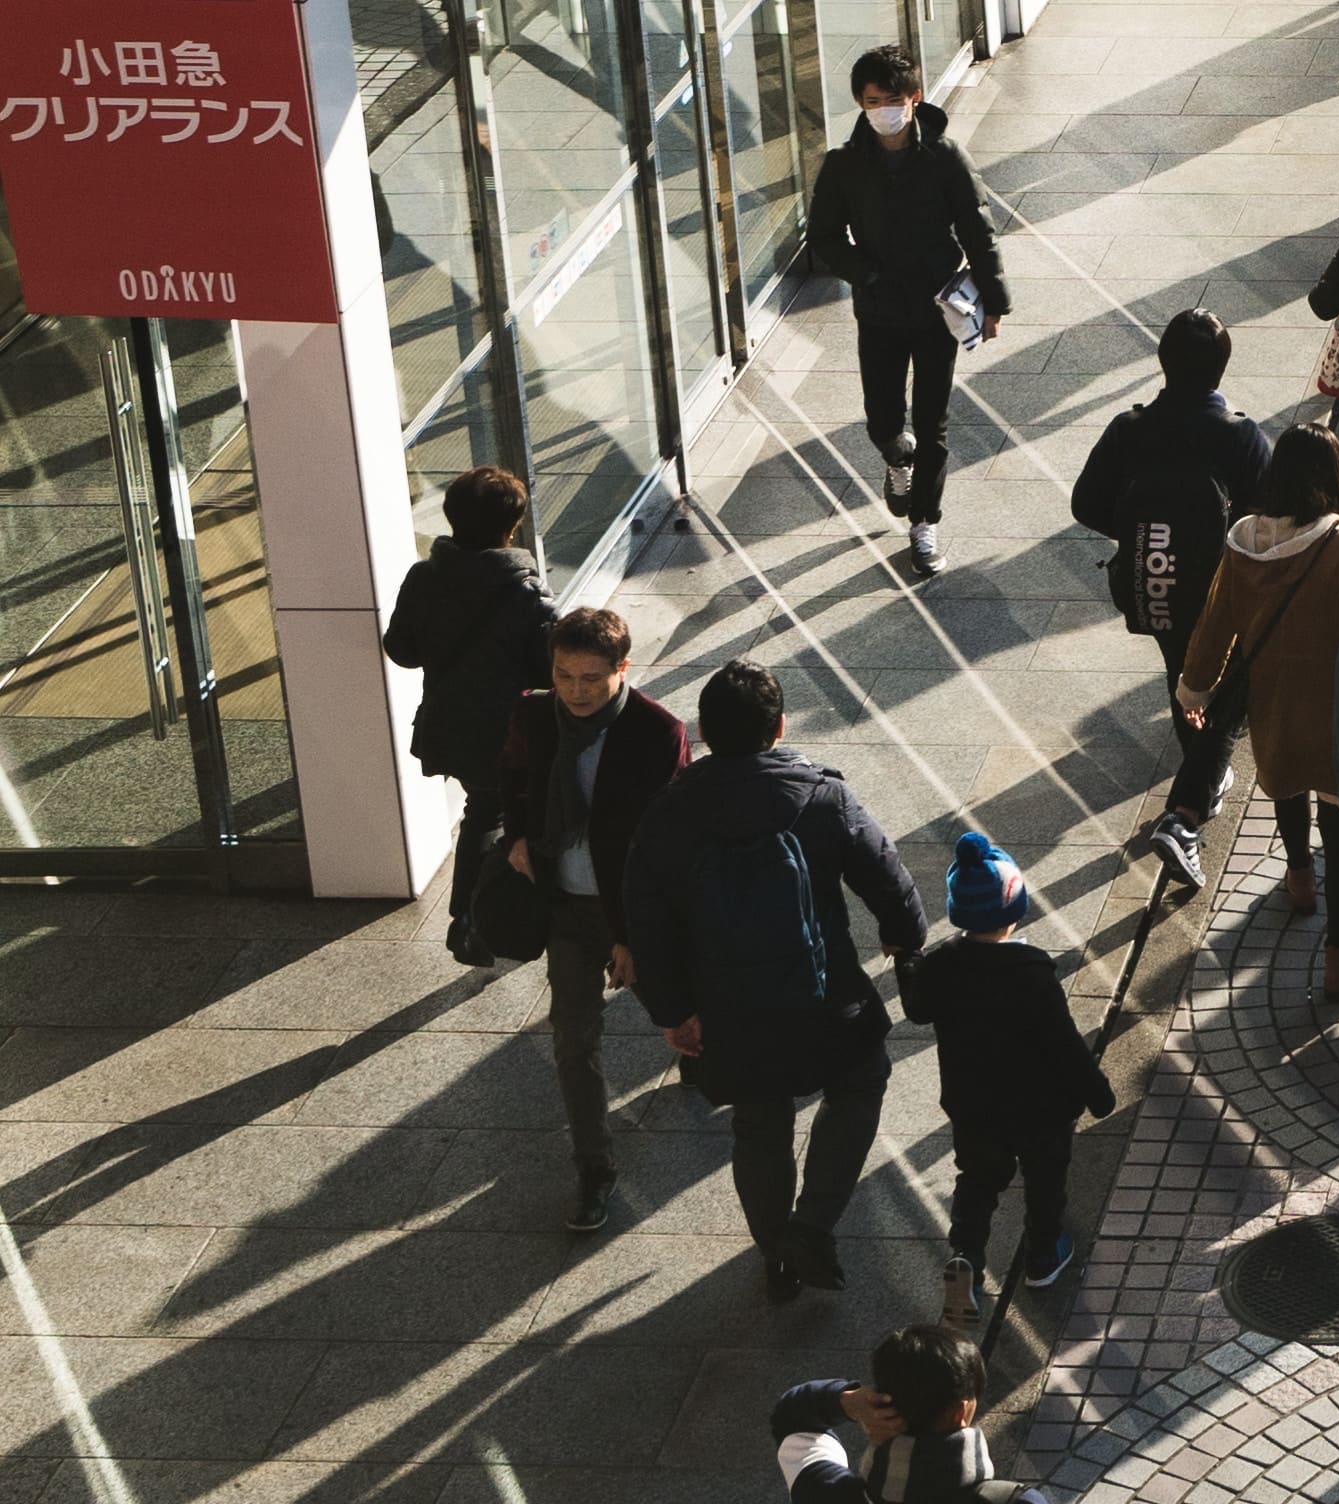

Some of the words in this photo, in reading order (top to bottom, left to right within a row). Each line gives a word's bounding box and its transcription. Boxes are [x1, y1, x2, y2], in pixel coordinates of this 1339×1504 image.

[60, 39, 228, 87] 小田急
[0, 96, 304, 147] クリアランス
[118, 265, 238, 305] ODAKYU
[1145, 522, 1177, 632] möbus
